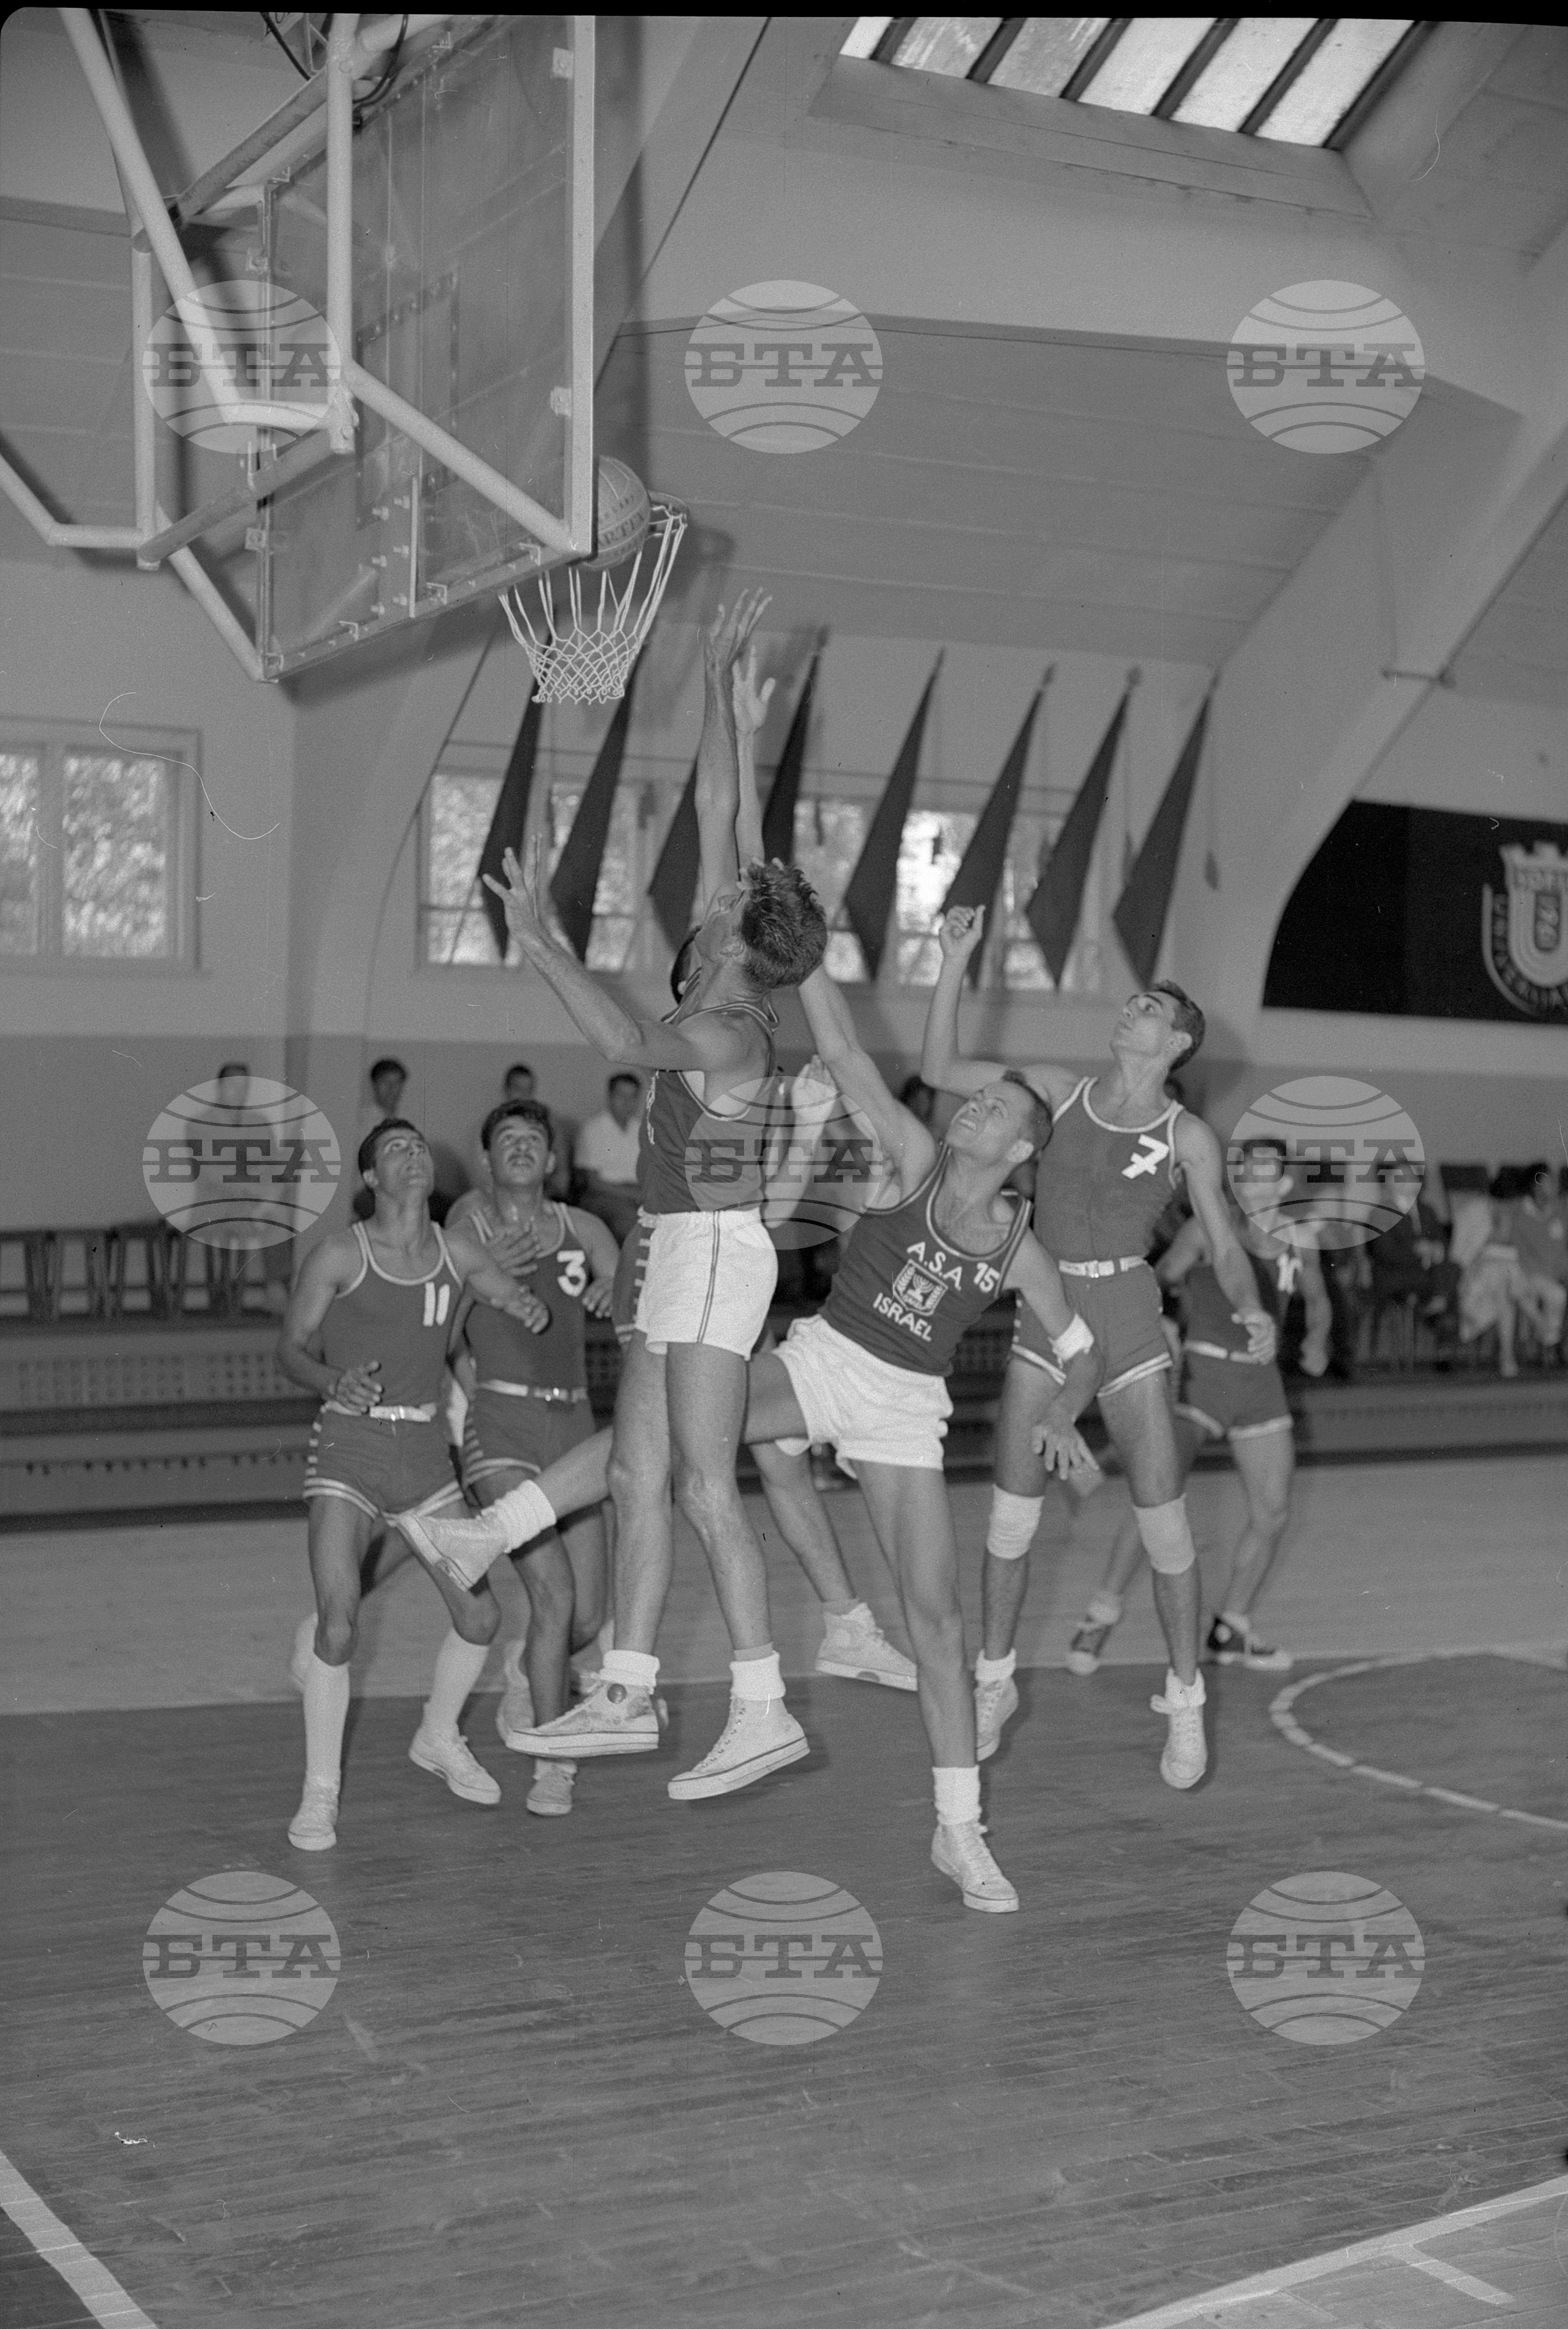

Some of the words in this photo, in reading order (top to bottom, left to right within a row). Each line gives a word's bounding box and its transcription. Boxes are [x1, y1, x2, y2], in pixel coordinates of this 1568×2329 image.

[1121, 1134, 1169, 1180] 7
[557, 1250, 586, 1297] 3
[974, 1262, 1000, 1293] 15
[423, 1281, 450, 1327] 11
[873, 1292, 932, 1342] ISRAEL
